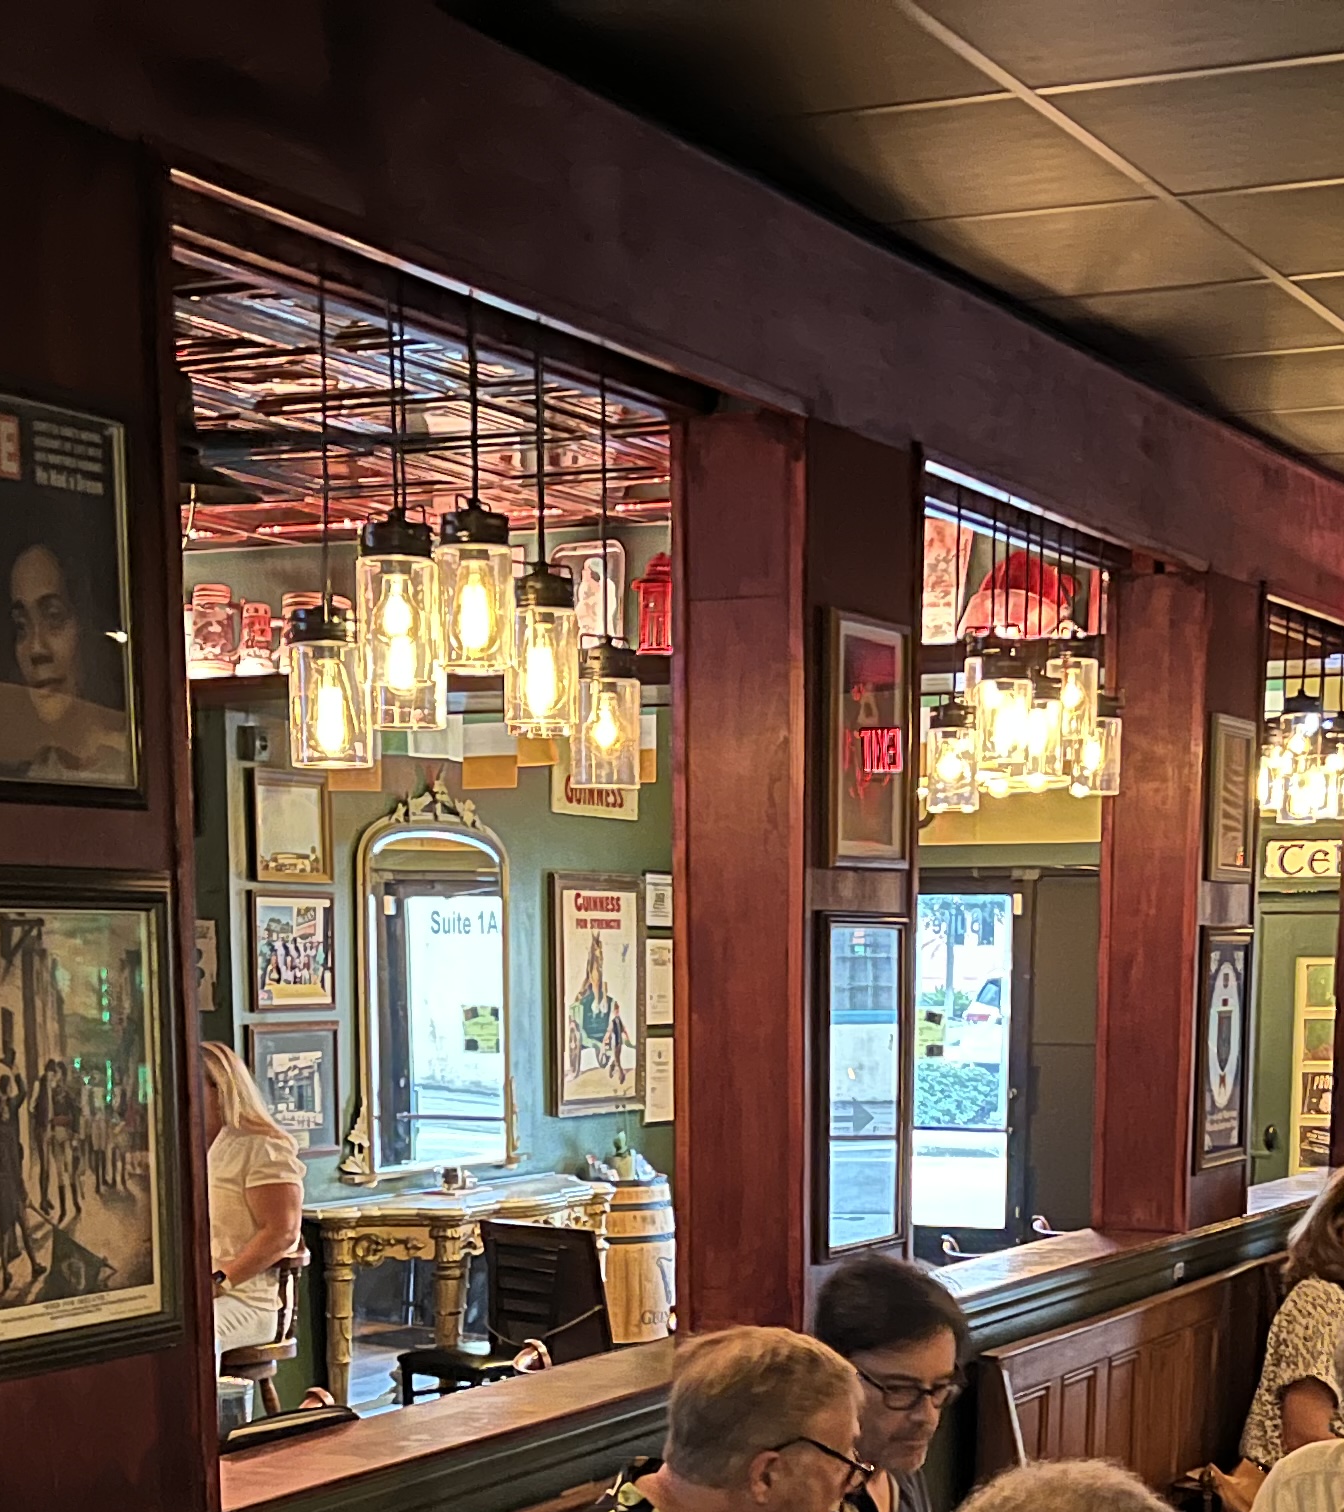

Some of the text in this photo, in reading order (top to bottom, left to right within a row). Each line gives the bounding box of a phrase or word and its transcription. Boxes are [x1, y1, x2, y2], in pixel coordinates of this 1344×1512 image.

[564, 774, 625, 809] GUINNESS
[574, 892, 621, 914] GUINNESS
[430, 910, 499, 935] Suite 1A
